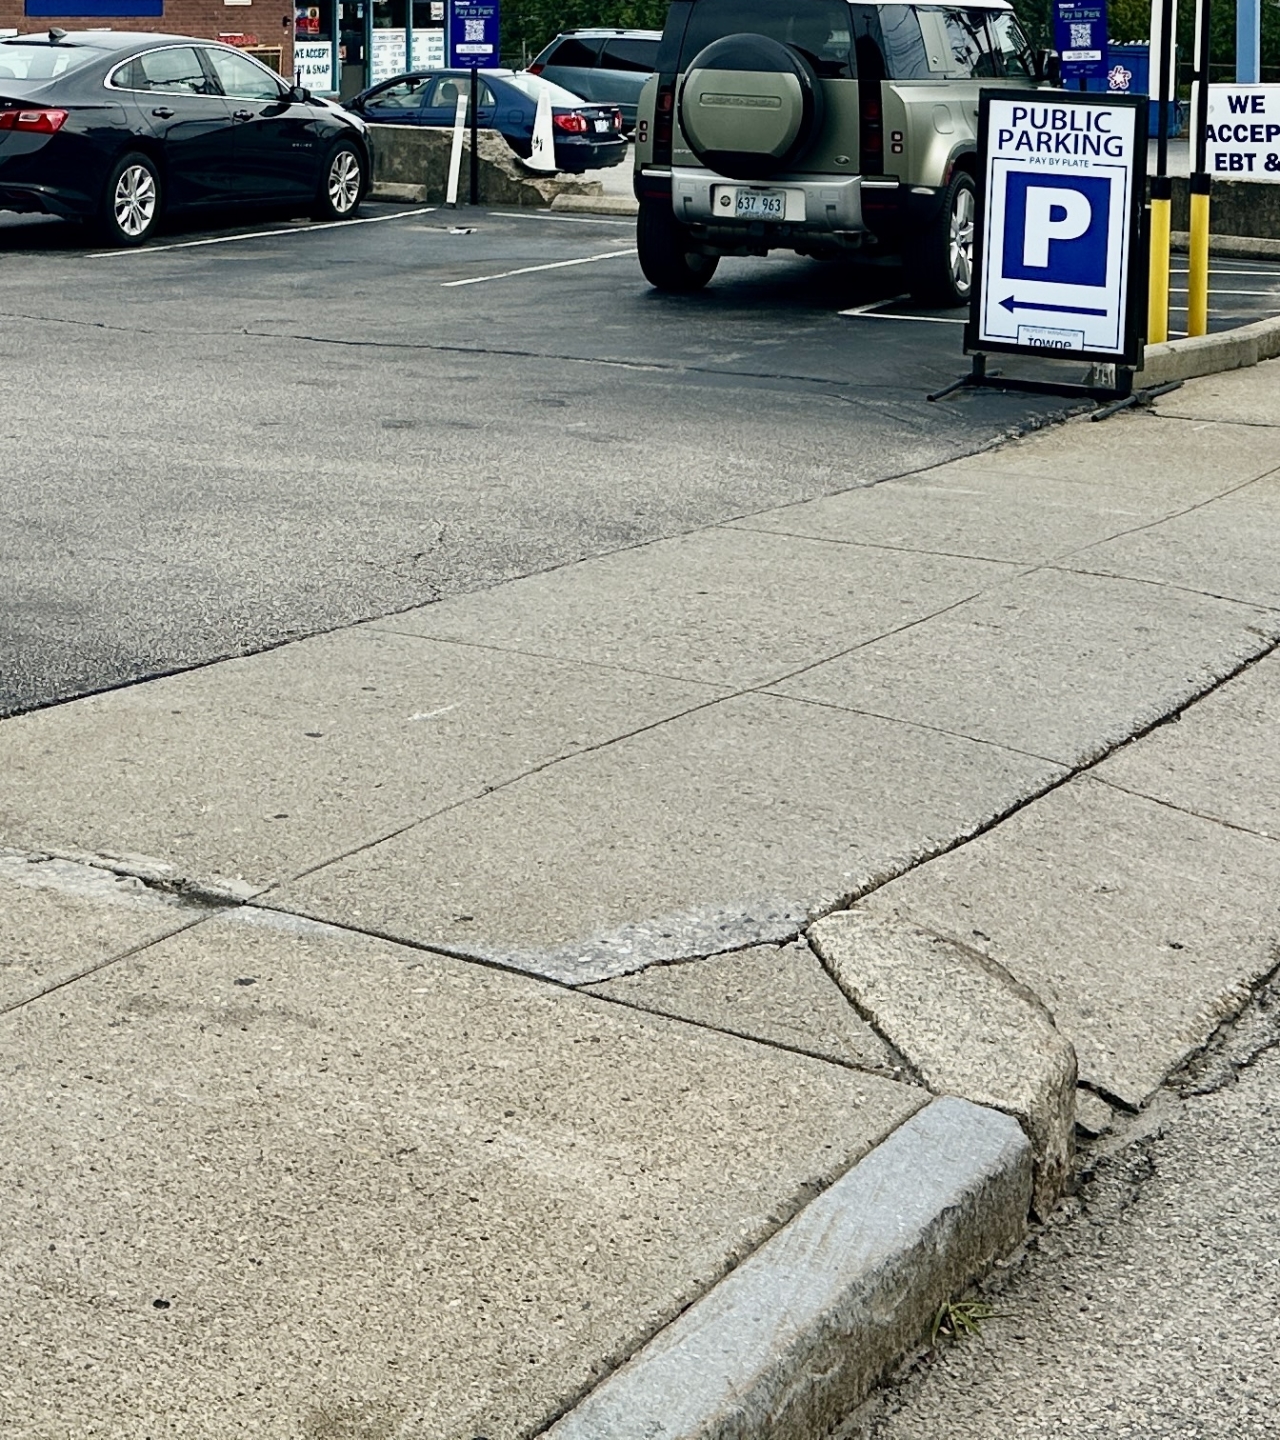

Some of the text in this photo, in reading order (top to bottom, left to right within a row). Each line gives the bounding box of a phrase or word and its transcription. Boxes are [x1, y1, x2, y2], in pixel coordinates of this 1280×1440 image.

[1227, 94, 1266, 114] WE
[1011, 106, 1112, 133] PUBLIC
[998, 128, 1124, 158] PARKING
[1029, 156, 1090, 168] PAY BY PLATE
[1214, 152, 1257, 172] EBT
[737, 196, 781, 212] 637 963
[1022, 185, 1092, 268] P
